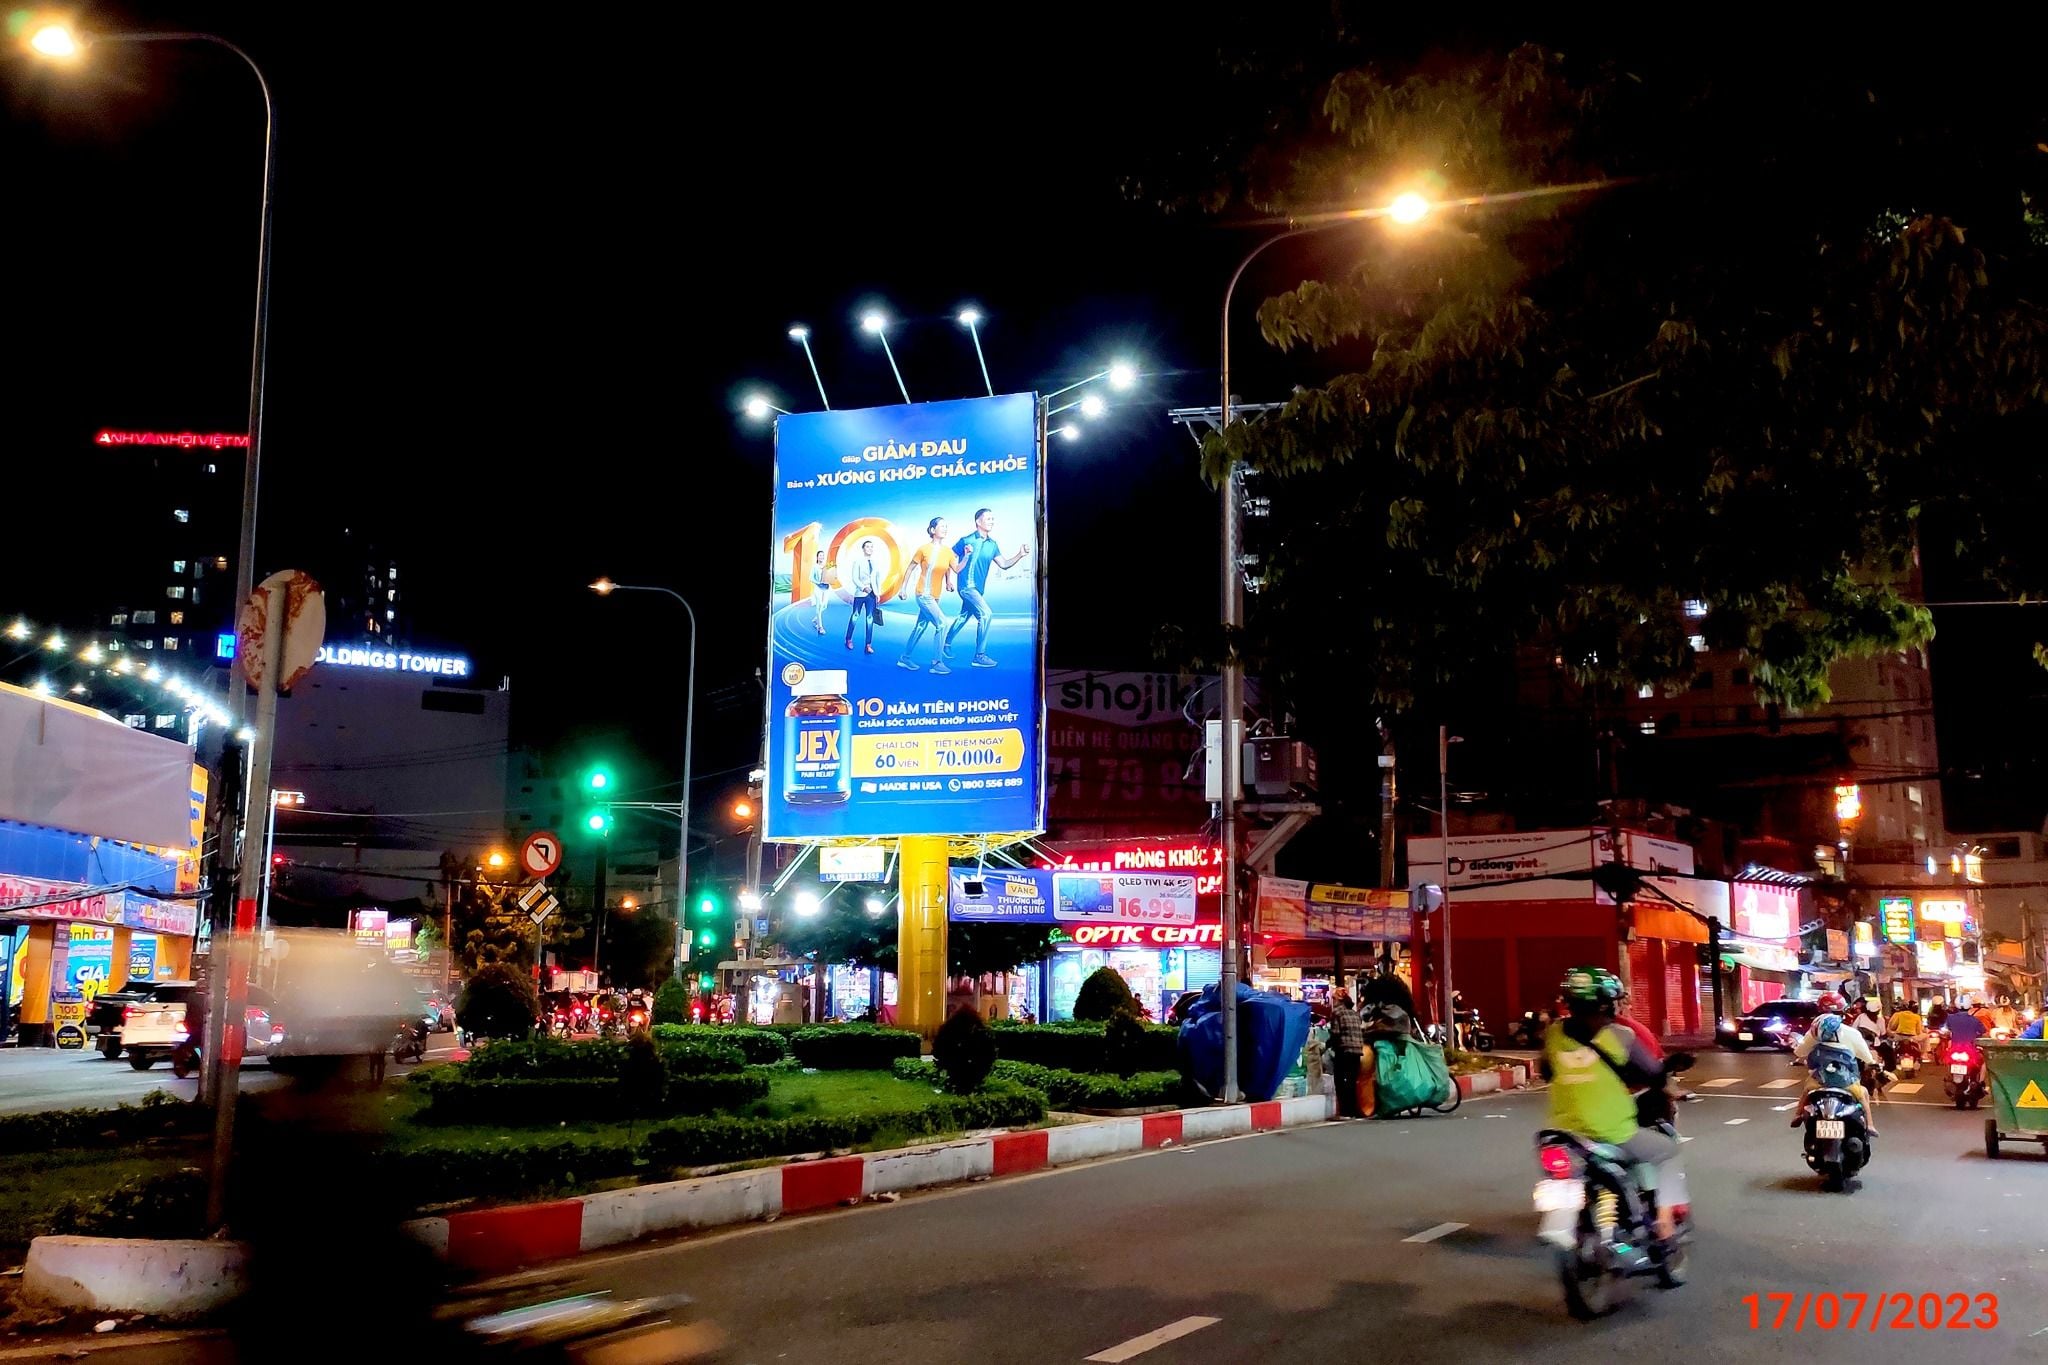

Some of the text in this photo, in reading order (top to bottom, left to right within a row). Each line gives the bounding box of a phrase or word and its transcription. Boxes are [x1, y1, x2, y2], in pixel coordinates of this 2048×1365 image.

[863, 439, 916, 462] GIẢM
[921, 438, 967, 456] ĐAU
[816, 469, 876, 487] XƯƠNG
[879, 464, 927, 482] KHỚP
[930, 458, 977, 477] CHẮC
[980, 454, 1028, 474] KHỎE
[399, 653, 466, 676] TOWER
[856, 697, 1009, 717] 10 NĂM TIÊN PHONG
[999, 713, 1019, 723] VIỆT
[796, 730, 840, 761] JEX
[875, 741, 898, 750] CHAI
[1051, 726, 1085, 746] LIÊN
[1092, 726, 1112, 748] HỆ
[875, 754, 896, 768] 60
[879, 781, 943, 791] MADE IN USA
[962, 779, 985, 789] 1800
[1115, 847, 1166, 869] PHÒNG
[1168, 845, 1208, 867] KHÚC
[1212, 847, 1222, 865] X
[1469, 856, 1538, 872] didongviet
[1118, 877, 1142, 886] QLED
[1144, 878, 1161, 886] TIVI
[1163, 879, 1175, 887] 4K
[997, 905, 1046, 915] SAMSUNG
[1118, 897, 1176, 919] 16.99
[1074, 925, 1145, 943] OPTIC
[1150, 924, 1223, 942] CENTE
